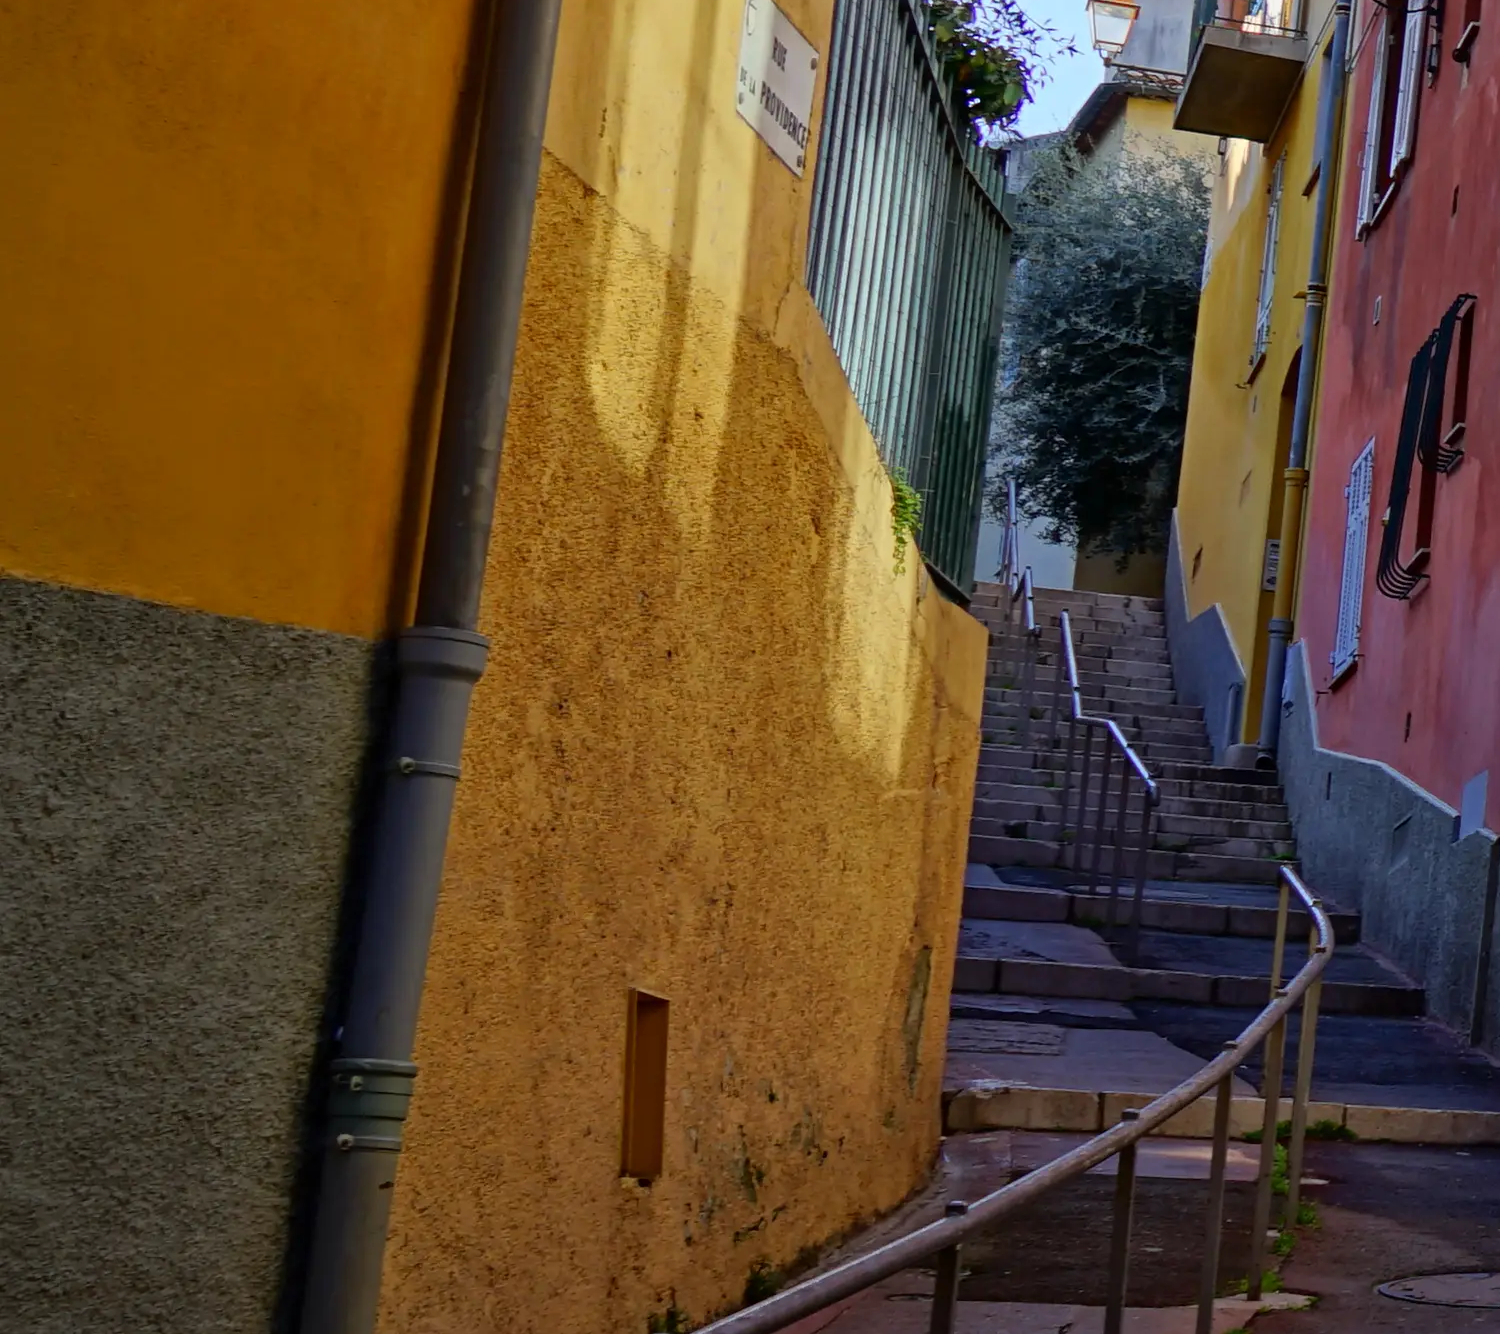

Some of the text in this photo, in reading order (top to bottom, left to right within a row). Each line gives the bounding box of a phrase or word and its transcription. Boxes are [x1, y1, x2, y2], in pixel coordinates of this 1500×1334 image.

[772, 36, 788, 73] RUE
[740, 65, 807, 150] DE LA PROVIDENCE
